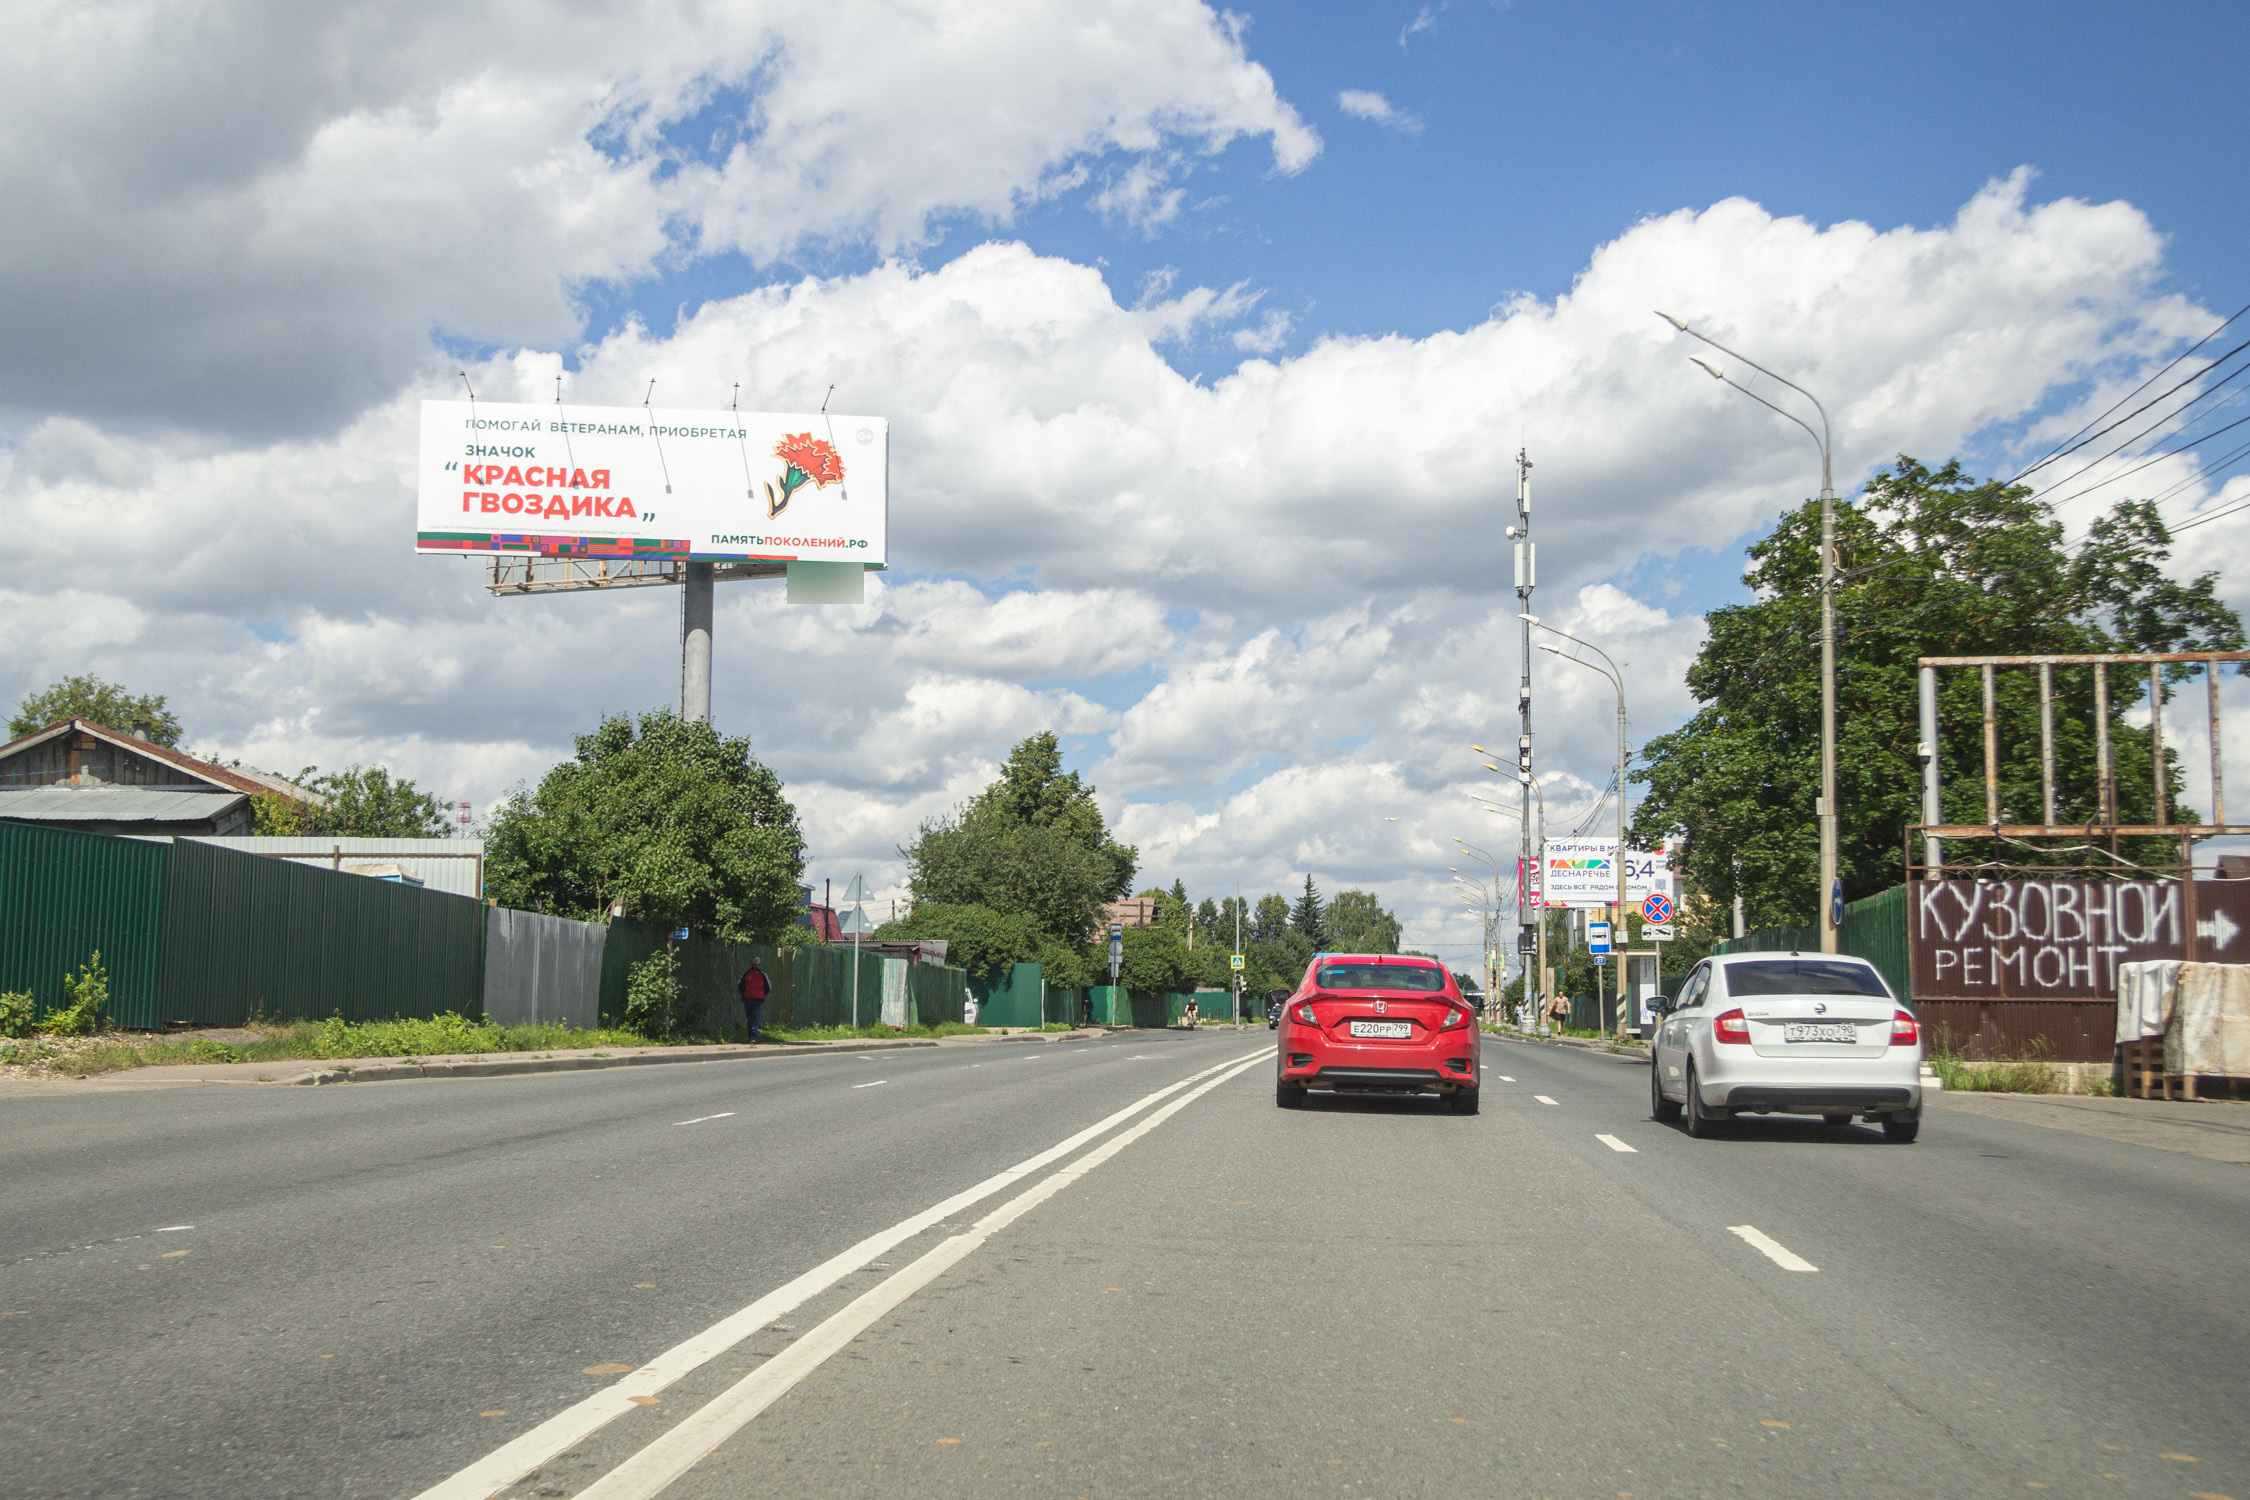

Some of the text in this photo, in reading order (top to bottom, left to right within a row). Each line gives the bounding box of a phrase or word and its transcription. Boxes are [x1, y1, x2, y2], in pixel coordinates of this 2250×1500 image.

[465, 418, 747, 440] ПОМОГАЙ ВЕТЕРАНАМ, ПРИОБРЕТАЯ
[465, 444, 536, 459] ЗНАЧОК
[711, 534, 868, 549] ПАМЯТЬПОКОЛЕНИЙ.РФ
[1550, 844, 1598, 852] КВАРТИРЫ
[1550, 870, 1611, 878] ДЕСНАРЕЧЬЕ
[1919, 880, 2182, 944] КУЗОВНОЙ
[1935, 945, 2129, 991] РЕМОНТ
